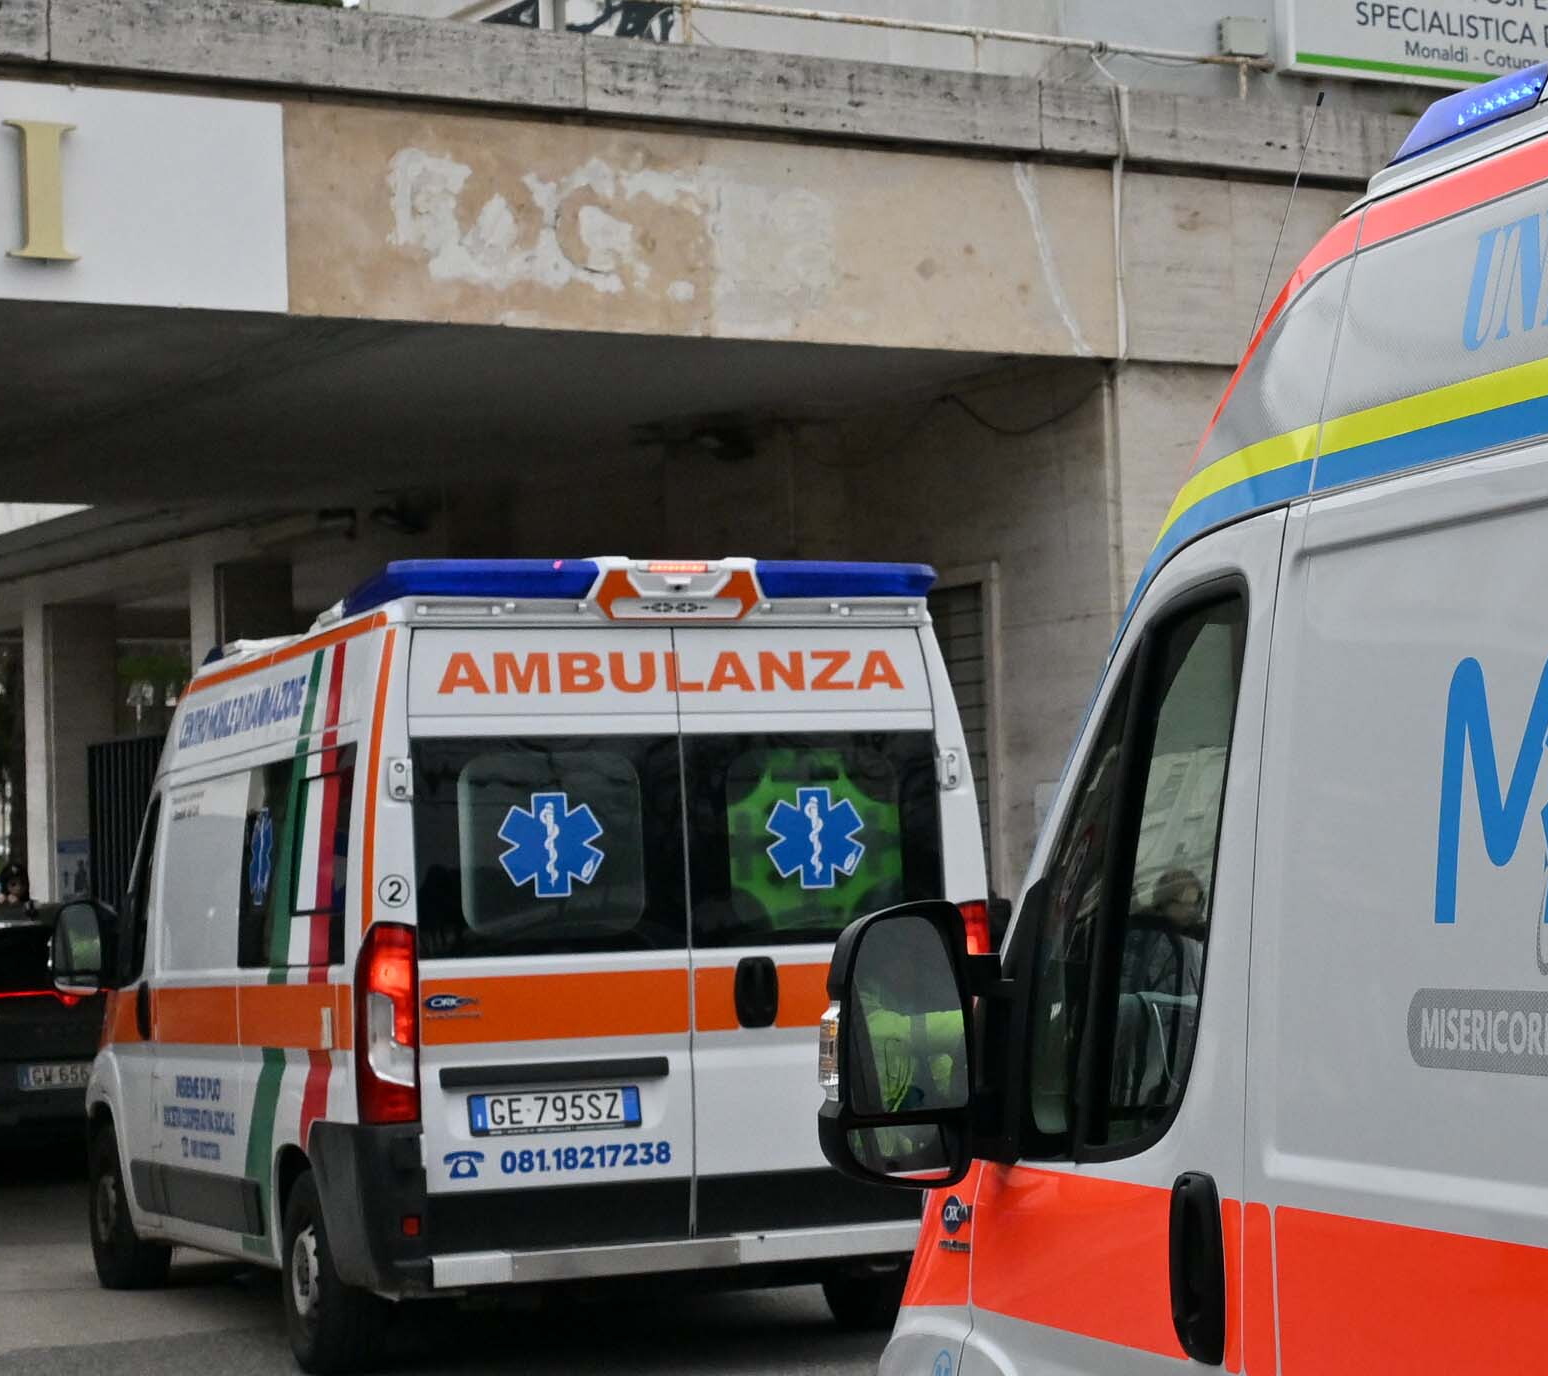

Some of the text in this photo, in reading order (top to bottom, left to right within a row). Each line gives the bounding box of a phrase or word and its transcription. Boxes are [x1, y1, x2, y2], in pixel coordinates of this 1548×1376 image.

[1355, 1, 1537, 46] SPECIALISTICA
[1404, 41, 1469, 64] Monaldi
[436, 650, 905, 695] AMBULANZA
[387, 880, 403, 903] 2
[533, 1092, 620, 1124] 795SZ
[501, 1141, 672, 1175] 081.18217238
